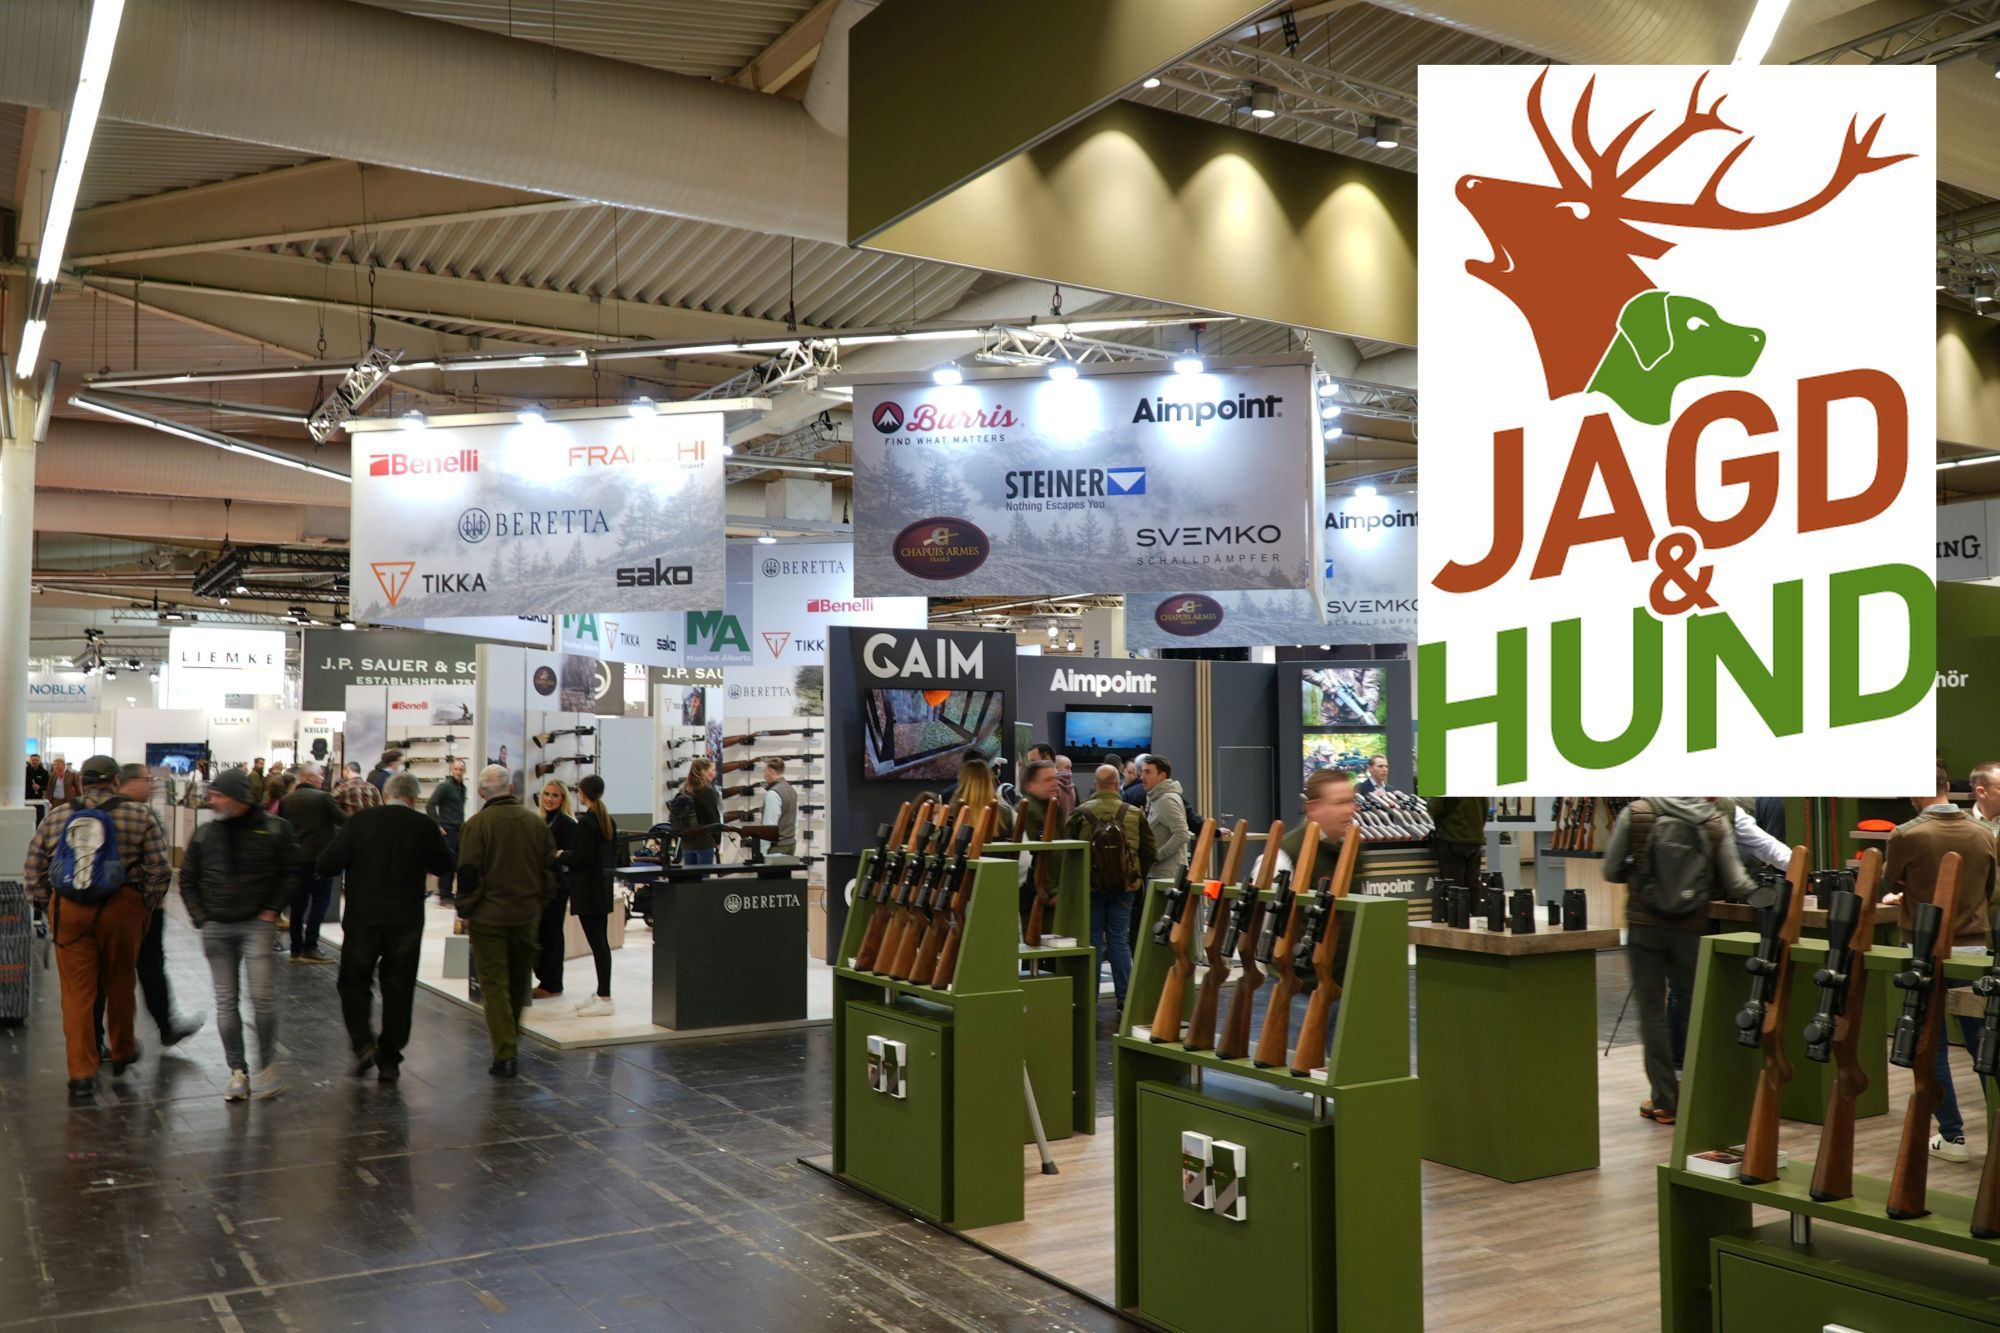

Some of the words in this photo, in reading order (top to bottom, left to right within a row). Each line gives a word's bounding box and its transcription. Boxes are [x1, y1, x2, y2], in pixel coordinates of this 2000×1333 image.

[906, 404, 1018, 432] Burris
[885, 437, 911, 446] FIND
[917, 436, 946, 444] WHAT
[953, 434, 1005, 444] MATTERS
[392, 449, 478, 475] Benelli
[1005, 468, 1104, 499] STEINER
[1006, 500, 1043, 512] Nothing
[1046, 500, 1086, 511] Escapes
[1088, 499, 1105, 509] You
[496, 509, 610, 537] BERETTA
[1136, 524, 1281, 547] SVEMKO
[901, 547, 944, 557] CHAPUIS
[946, 546, 980, 556] ARMES
[783, 560, 845, 574] BERETTA
[1137, 553, 1280, 566] SCHALLDÄMPFER
[617, 558, 693, 587] sako
[422, 573, 487, 593] TIKKA
[820, 598, 873, 613] Benelli
[1160, 614, 1191, 622] CHAPUIS
[687, 610, 751, 652] MA
[621, 632, 640, 648] TIKKA
[657, 634, 676, 651] sako
[182, 651, 272, 664] LIEMKE
[721, 654, 752, 662] Alberts
[863, 633, 984, 679] GAIM
[321, 657, 354, 670] J.P.
[361, 658, 428, 672] SAUER
[435, 661, 448, 673] &
[662, 667, 689, 679] J.P.
[356, 676, 447, 686] ESTABLISHED
[30, 684, 86, 695] NOBLEX
[743, 686, 792, 697] BERETTA
[399, 701, 429, 710] Benelli
[743, 894, 800, 910] BERETTA
